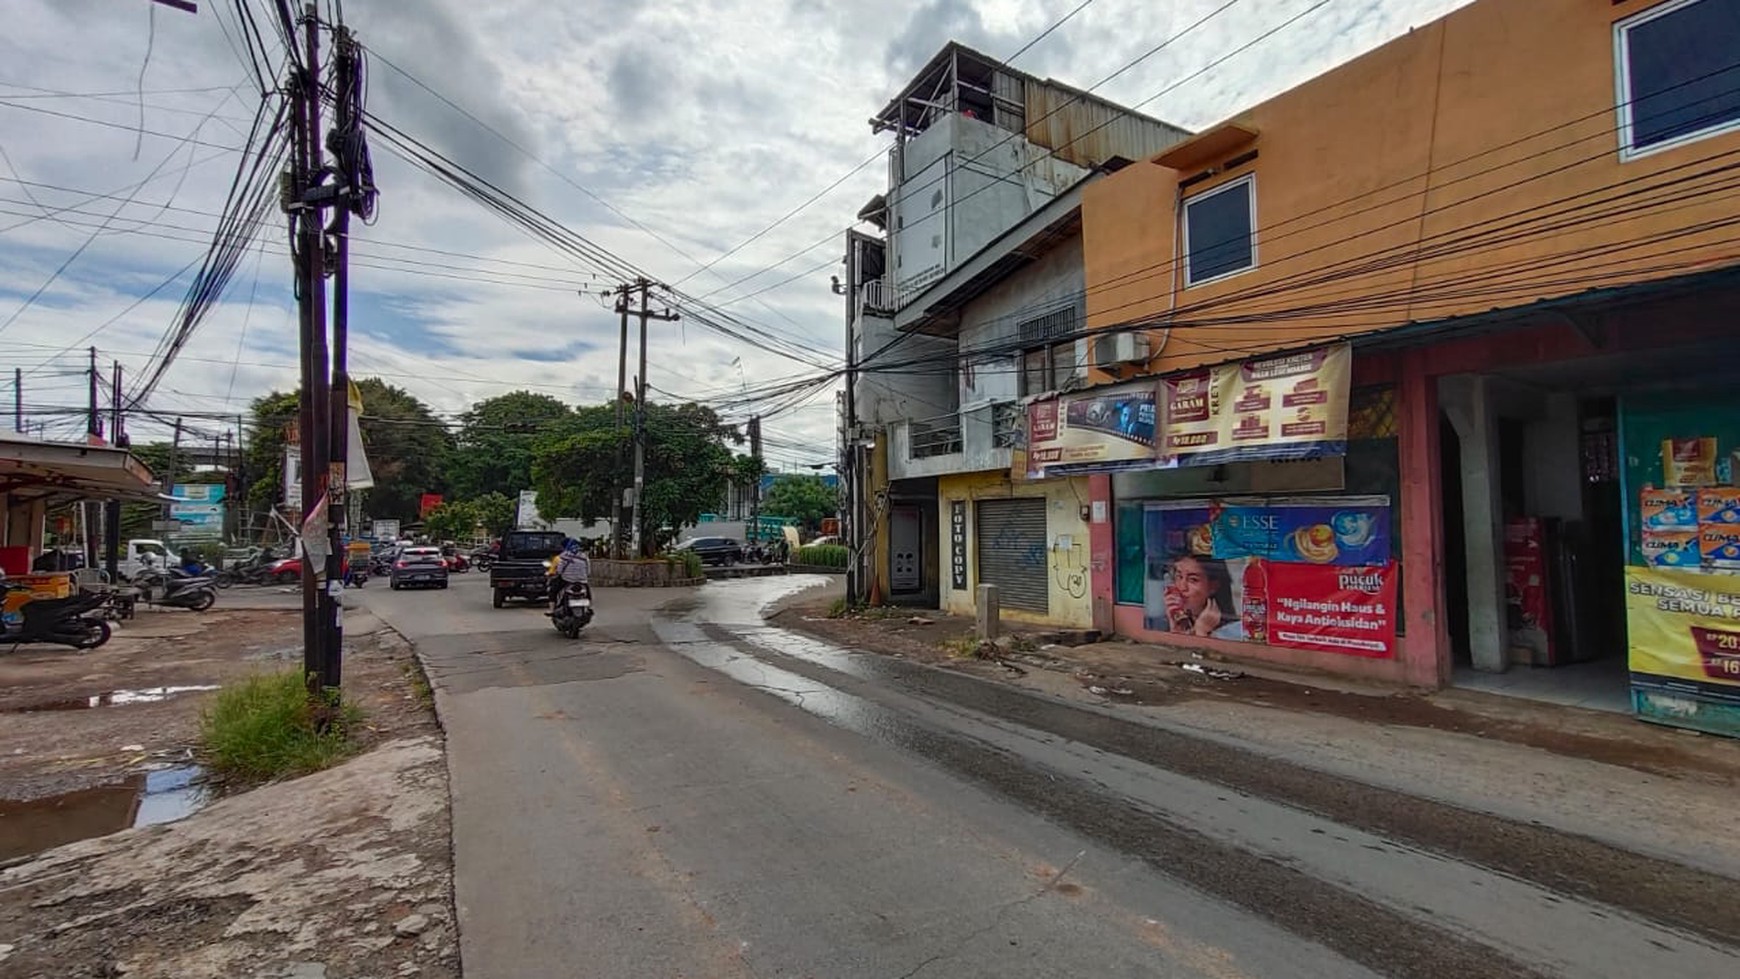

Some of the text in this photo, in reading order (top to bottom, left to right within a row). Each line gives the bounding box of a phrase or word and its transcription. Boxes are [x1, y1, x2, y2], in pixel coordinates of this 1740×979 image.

[1243, 514, 1279, 530] ESSE
[1338, 573, 1383, 590] pucuk
[1630, 582, 1709, 600] SENSASI
[1340, 601, 1373, 614] Haus
[1374, 603, 1386, 614] &
[1657, 598, 1724, 617] SEMUA
[1276, 611, 1304, 625] Kaya
